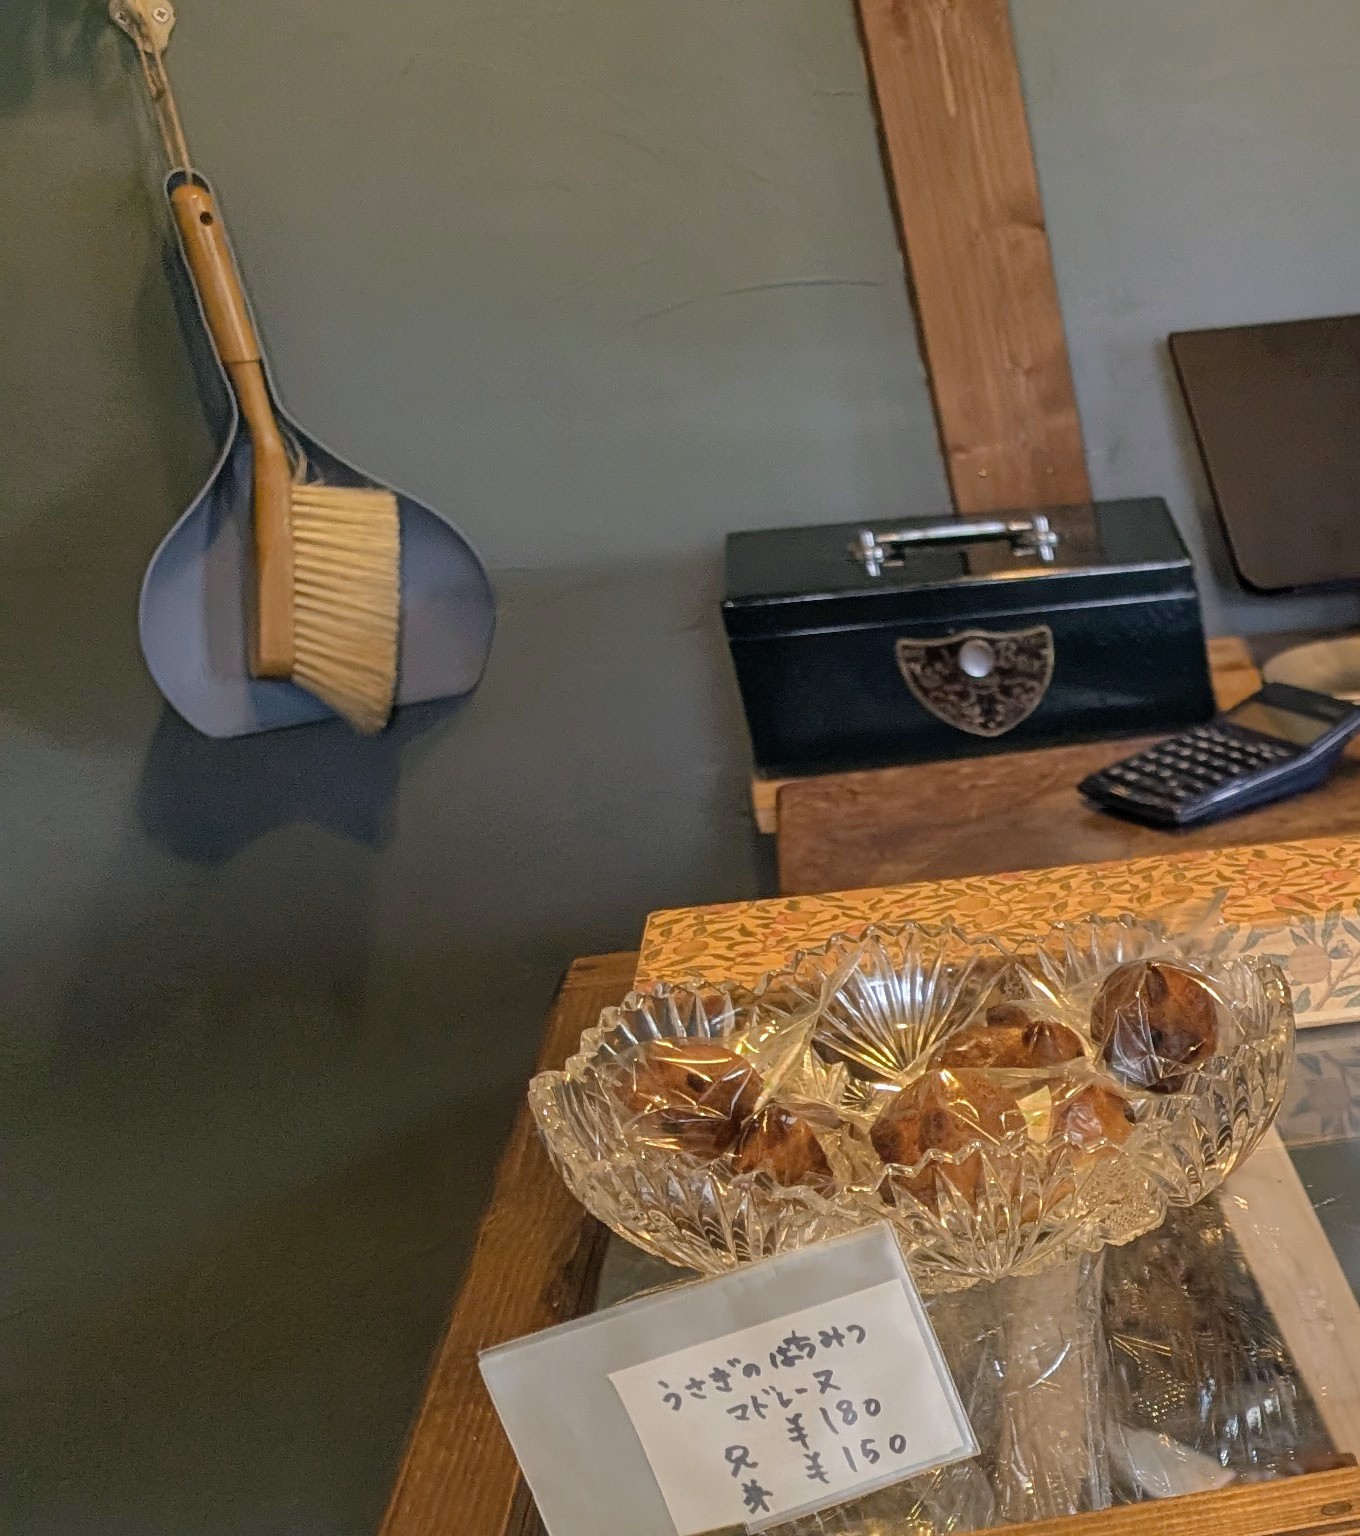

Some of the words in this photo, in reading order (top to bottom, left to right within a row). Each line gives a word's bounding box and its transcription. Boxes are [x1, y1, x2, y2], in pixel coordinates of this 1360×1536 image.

[726, 1370, 842, 1423] マドレーヌ
[724, 1445, 760, 1478] 兄
[787, 1397, 883, 1448] ¥180
[805, 1433, 908, 1485] ¥150
